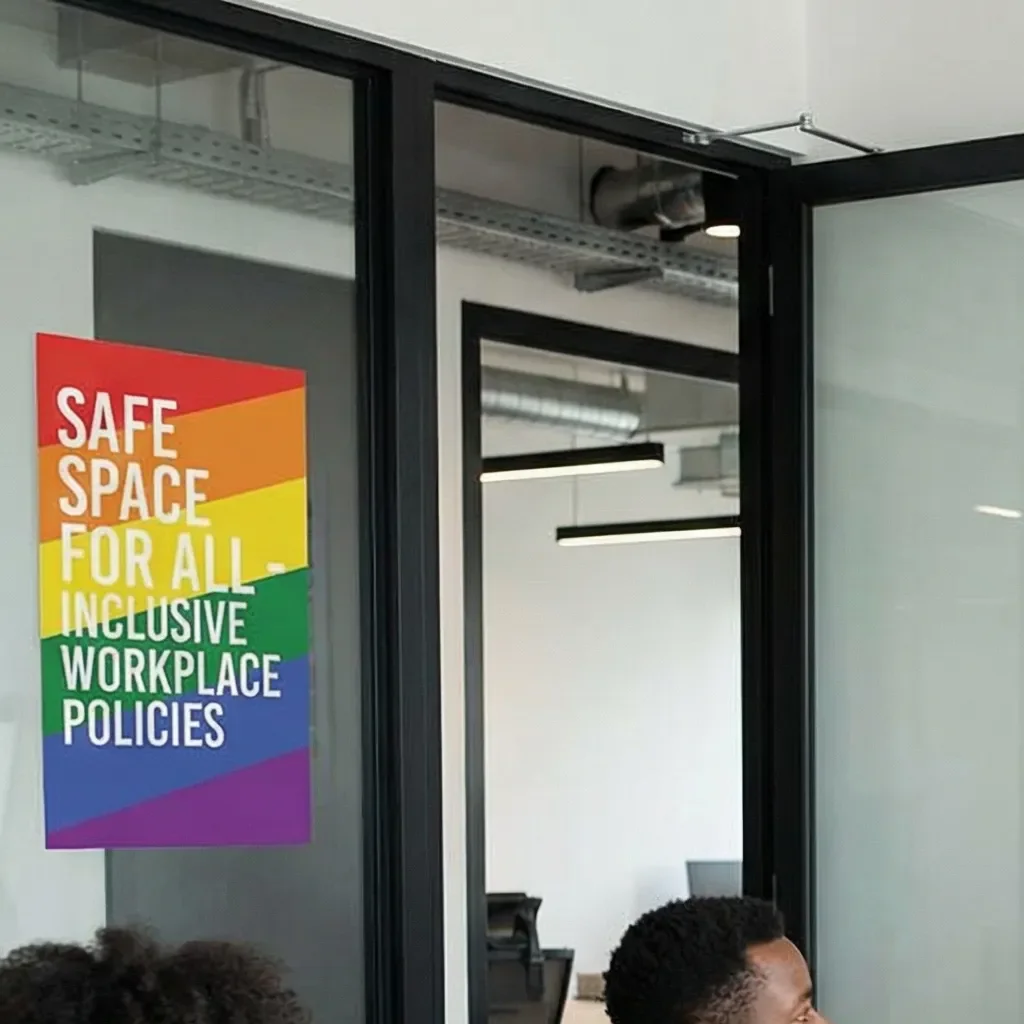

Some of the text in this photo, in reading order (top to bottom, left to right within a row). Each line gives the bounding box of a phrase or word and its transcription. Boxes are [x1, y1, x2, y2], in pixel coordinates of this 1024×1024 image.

[57, 386, 177, 458] SAFE
[58, 455, 210, 527] SPACE
[60, 522, 153, 588] FOR
[61, 590, 247, 646] INCLUSIVE
[60, 644, 281, 698] WORKPLACE
[63, 698, 225, 748] POLICIES
